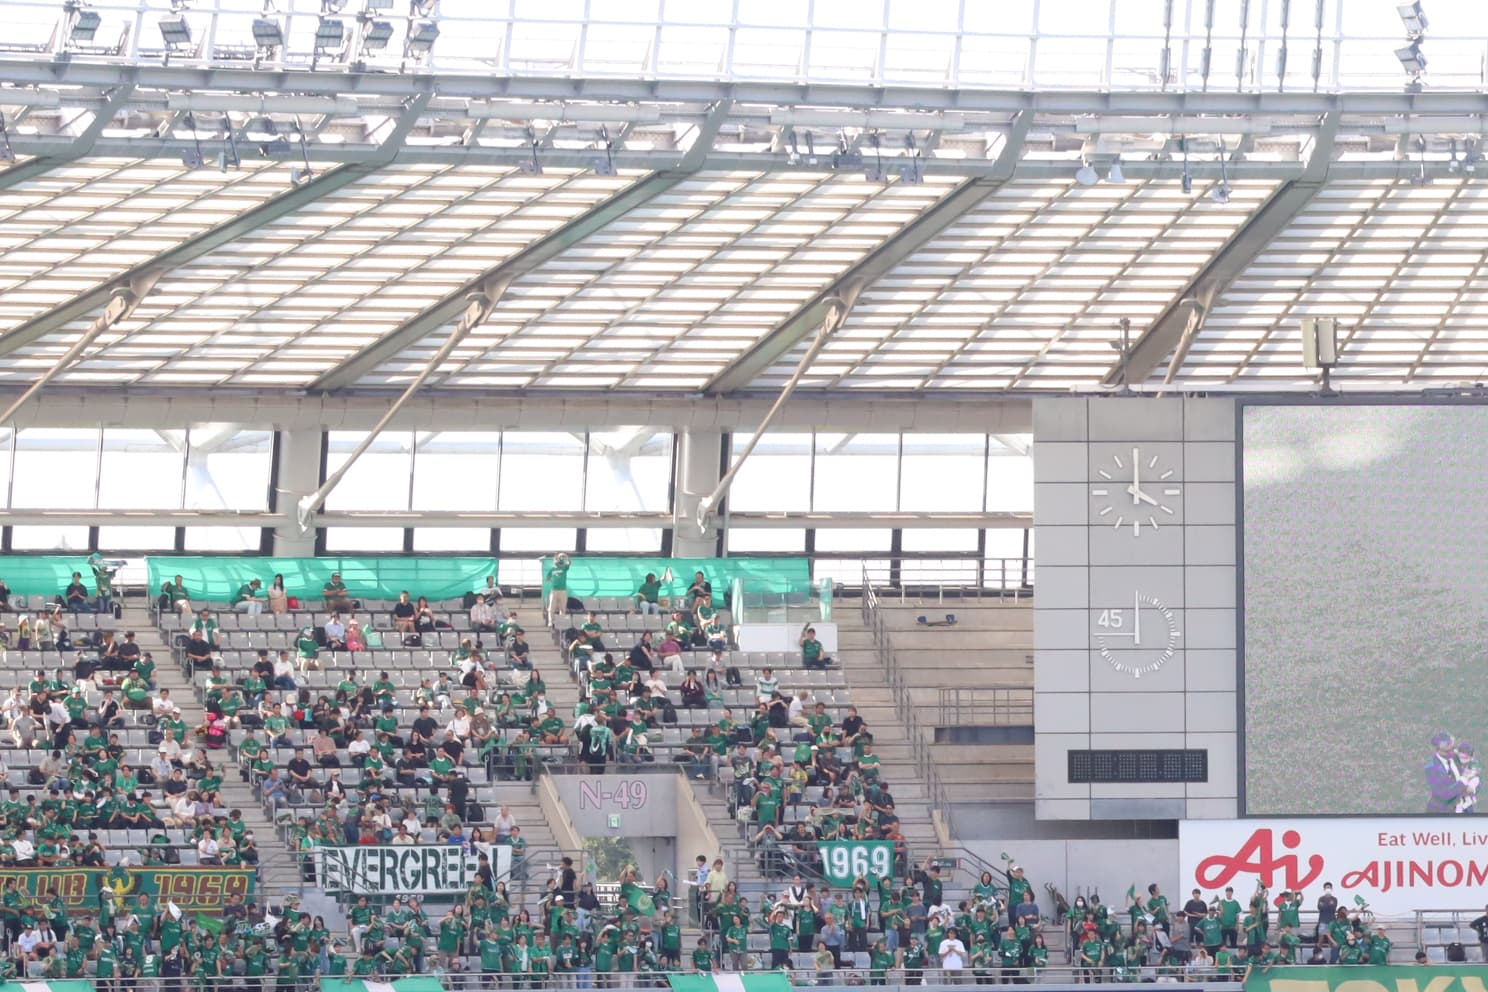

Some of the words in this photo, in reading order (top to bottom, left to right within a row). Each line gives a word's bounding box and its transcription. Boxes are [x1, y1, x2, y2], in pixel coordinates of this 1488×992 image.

[1098, 609, 1122, 628] 45
[579, 780, 647, 810] N-49
[1377, 832, 1406, 847] Eat
[1412, 831, 1456, 849] Well,
[820, 846, 891, 880] 1969
[0, 874, 88, 906] LUB
